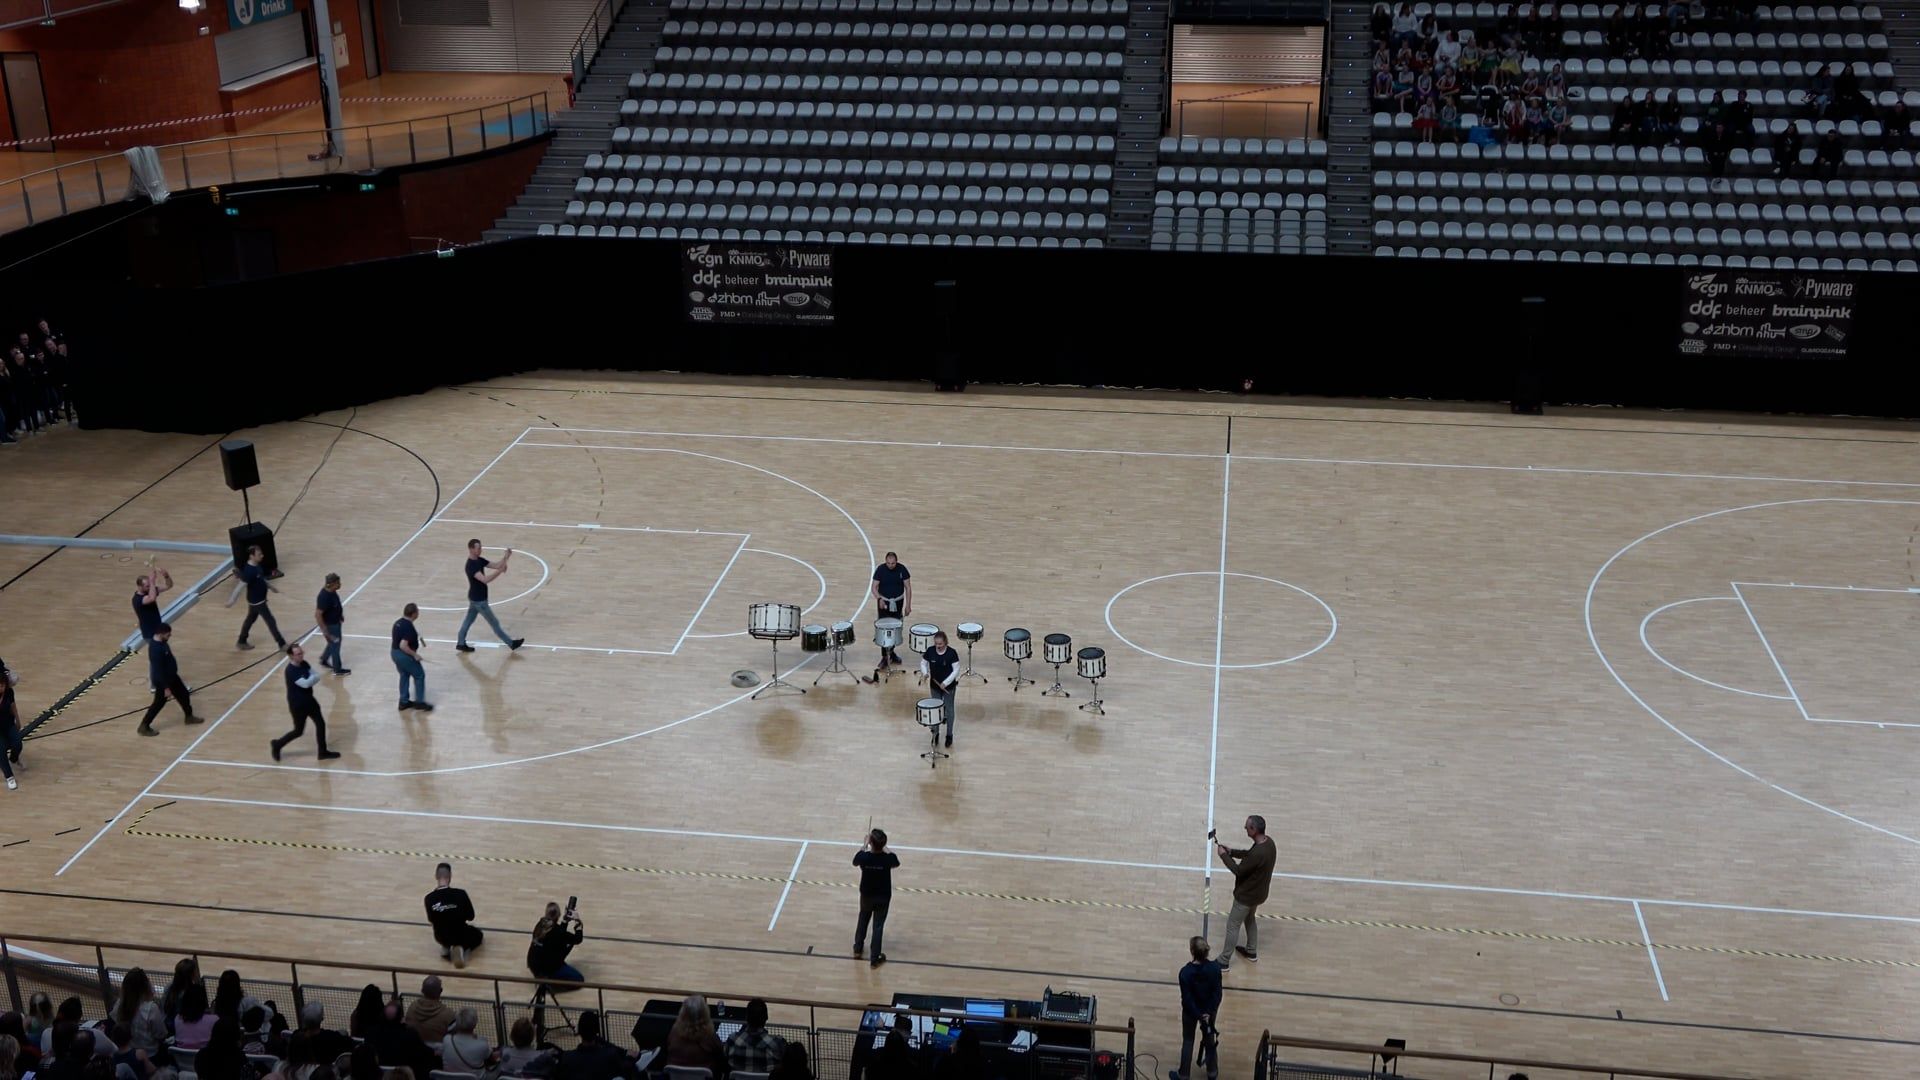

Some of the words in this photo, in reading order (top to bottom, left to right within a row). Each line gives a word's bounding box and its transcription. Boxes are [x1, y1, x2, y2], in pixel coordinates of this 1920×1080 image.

[261, 0, 286, 16] Drinks
[698, 254, 723, 268] cgn
[789, 249, 831, 268] Pyware
[692, 269, 721, 288] ddf
[725, 275, 759, 285] beheer
[765, 274, 833, 288] brainpink
[1700, 282, 1728, 297] cgn
[1805, 278, 1853, 298] Pyware
[1689, 299, 1722, 319] ddf
[1726, 304, 1766, 315] beheer
[1772, 304, 1851, 320] brainpink
